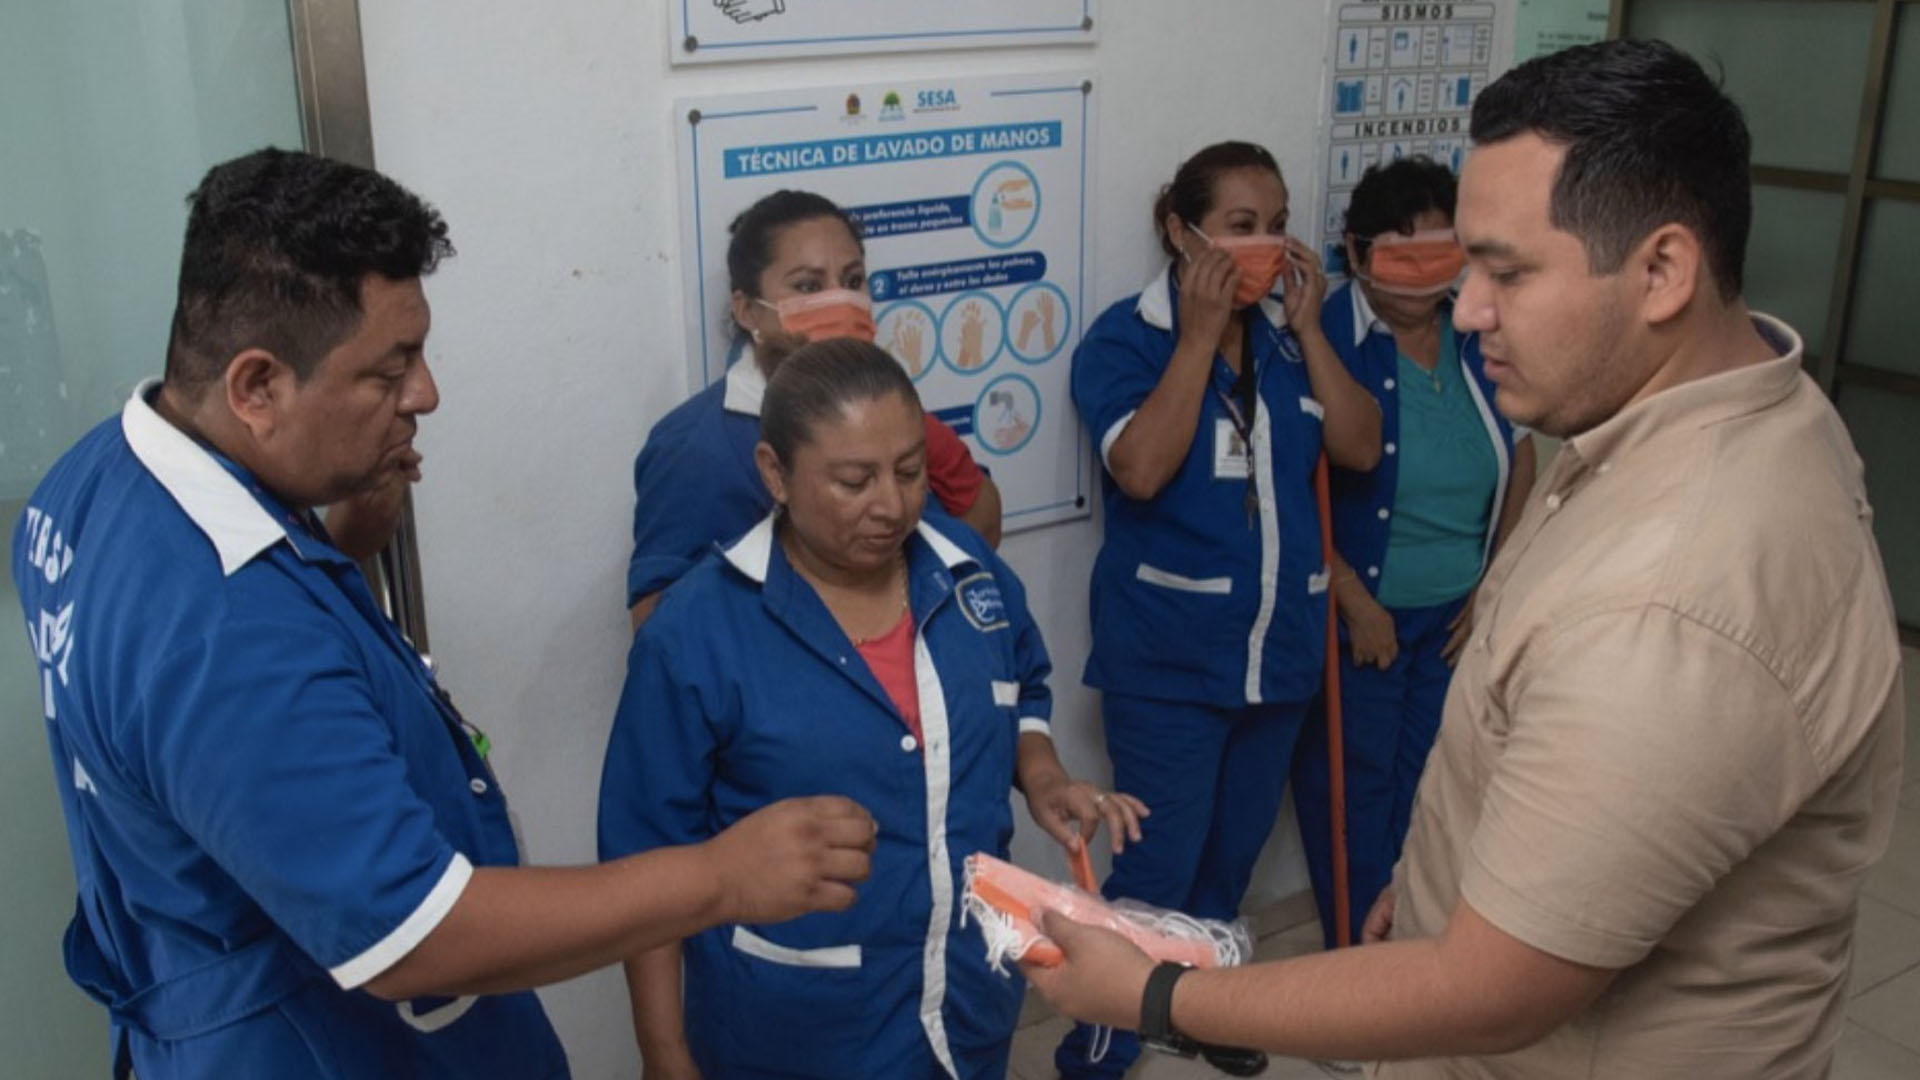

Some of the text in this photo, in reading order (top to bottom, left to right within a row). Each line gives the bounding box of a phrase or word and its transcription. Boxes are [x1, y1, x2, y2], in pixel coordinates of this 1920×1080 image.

[1382, 4, 1454, 20] SISMOS
[917, 88, 957, 107] SESA
[1354, 117, 1460, 137] INCENDIOS
[738, 127, 1051, 173] TÉCNICA DE LAVADO DE MANOS
[873, 278, 885, 294] 2
